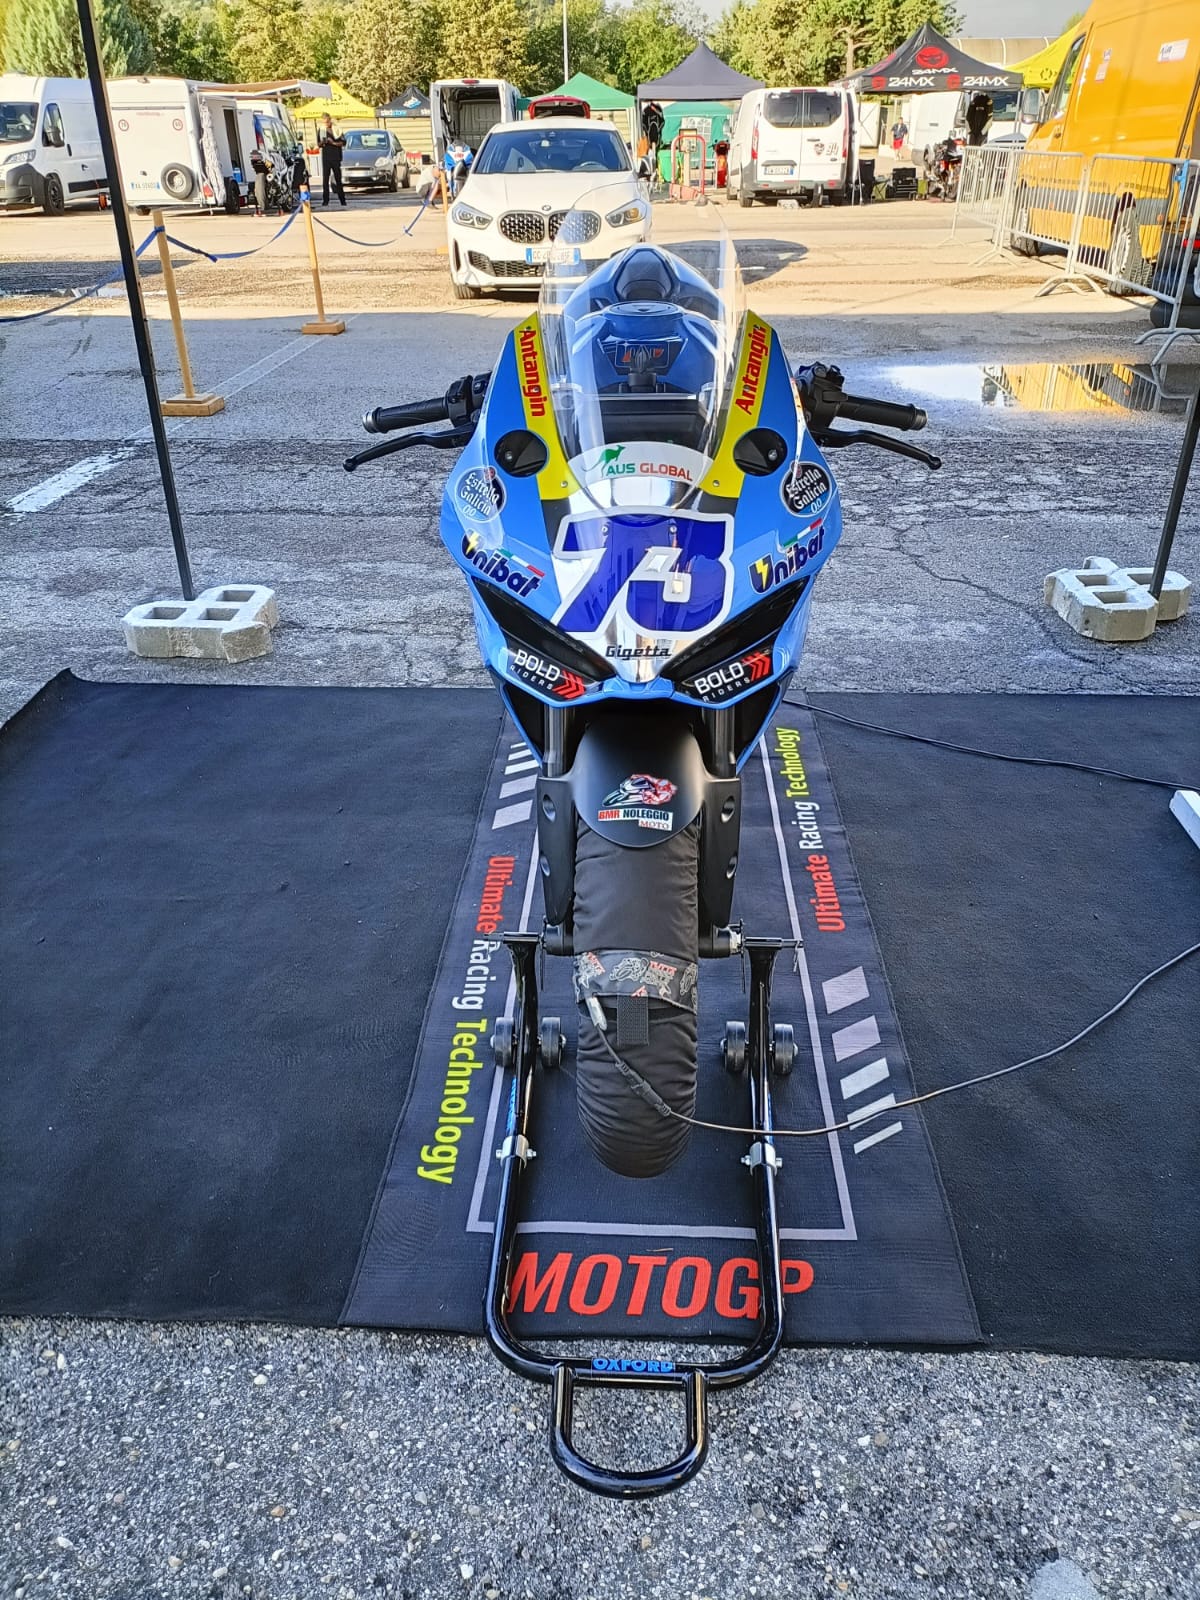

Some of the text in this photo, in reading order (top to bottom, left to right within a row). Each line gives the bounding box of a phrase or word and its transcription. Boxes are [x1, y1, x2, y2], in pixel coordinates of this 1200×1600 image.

[888, 76, 1009, 87] 24MX 24MX
[912, 67, 959, 76] 24MX
[519, 330, 547, 416] Antangin
[735, 326, 769, 415] Antangin
[606, 463, 693, 481] AUS GLOBAL
[786, 468, 822, 498] Estrella
[460, 485, 492, 516] Galicia
[465, 472, 500, 505] Estrella
[793, 481, 827, 510] Galicia
[461, 529, 541, 598] Unibat
[553, 508, 732, 636] 73
[748, 524, 825, 594] Unibat
[514, 649, 560, 682] BOLD
[605, 645, 672, 661] Gigetta
[510, 664, 554, 690] RIDERS
[694, 662, 744, 695] BOLD
[702, 677, 750, 703] RIDERS
[598, 809, 669, 821] BMR NOLEGGIO
[640, 820, 670, 830] MOTO
[775, 727, 846, 932] Ultimate Racing Technology
[417, 855, 515, 1185] Ultimate Racing Technology
[506, 1252, 815, 1321] MOTOGP
[593, 1358, 676, 1374] OXFORD
